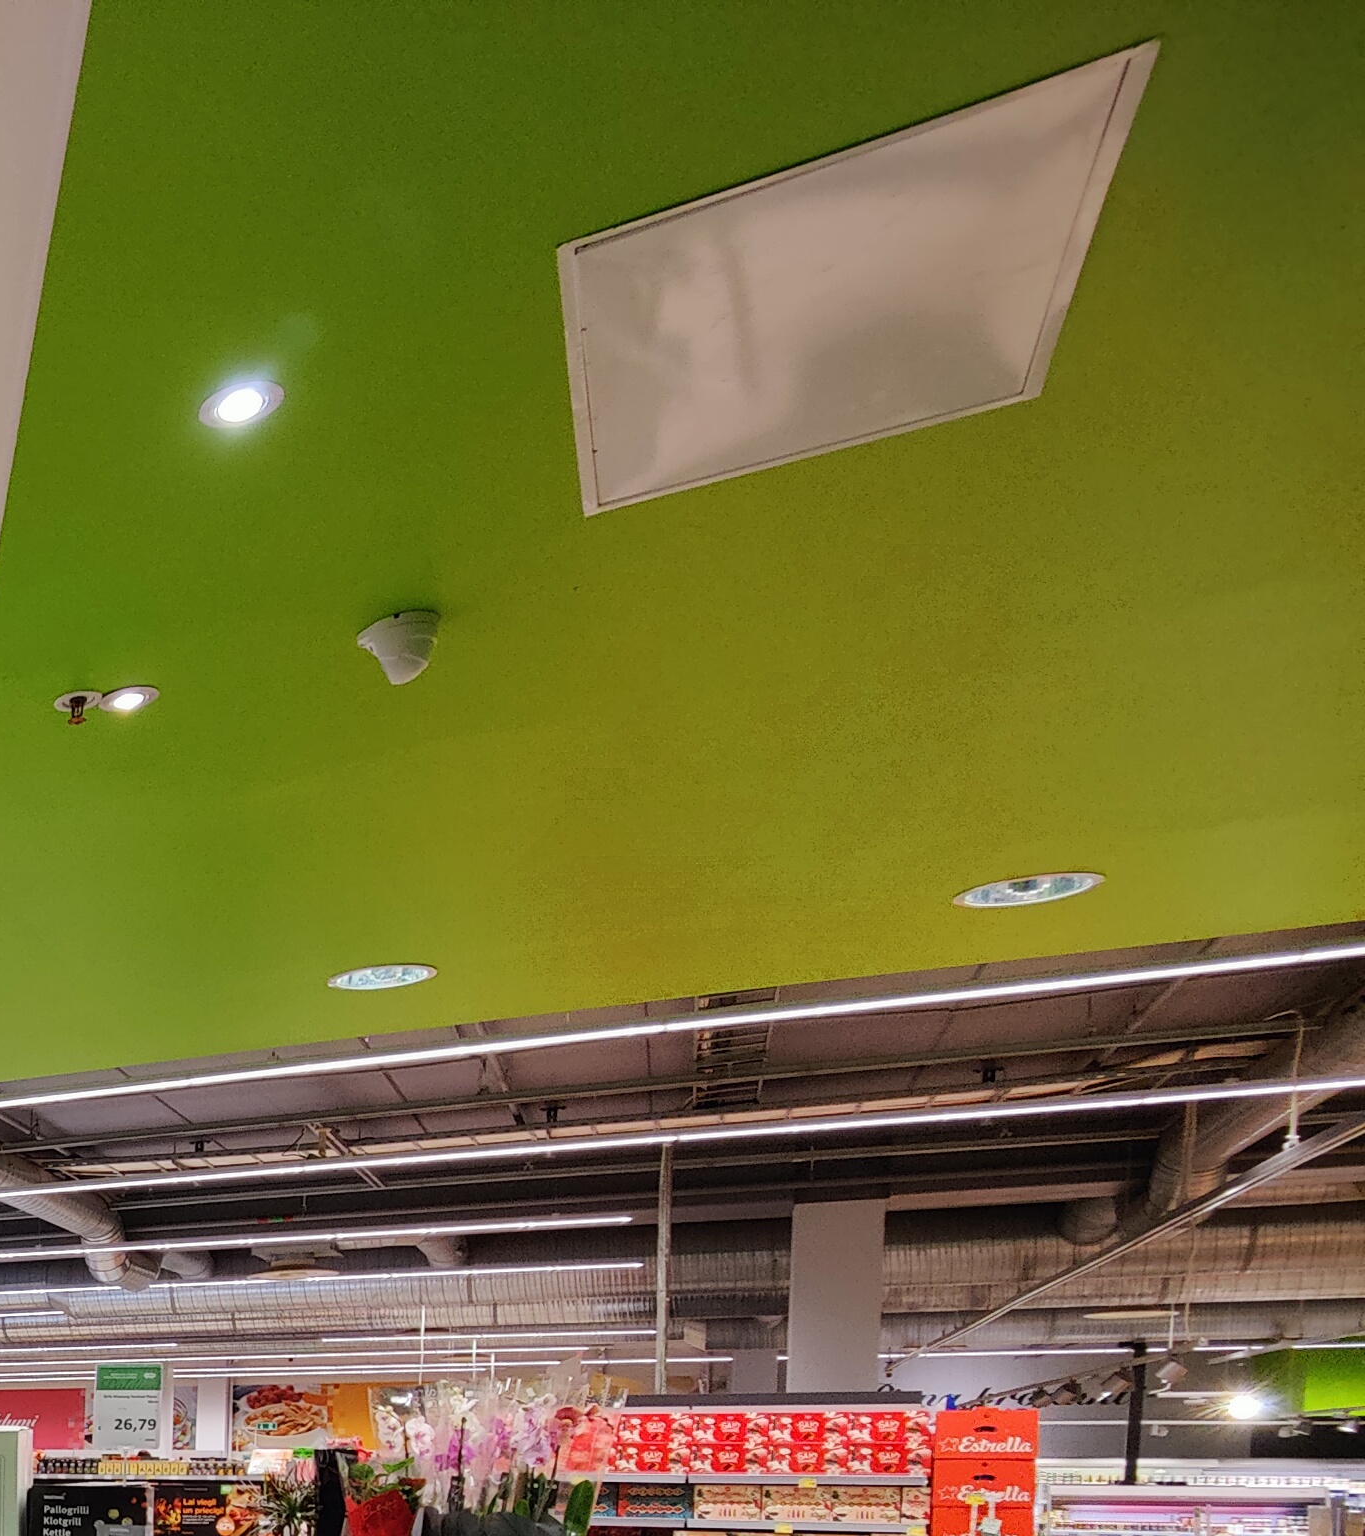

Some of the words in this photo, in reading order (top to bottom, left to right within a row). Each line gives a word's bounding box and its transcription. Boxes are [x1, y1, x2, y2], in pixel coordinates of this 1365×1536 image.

[114, 1418, 157, 1433] 26,79
[959, 1436, 1034, 1453] Estrella
[43, 1505, 90, 1516] Pallogrilli
[43, 1517, 82, 1527] Klotgrill
